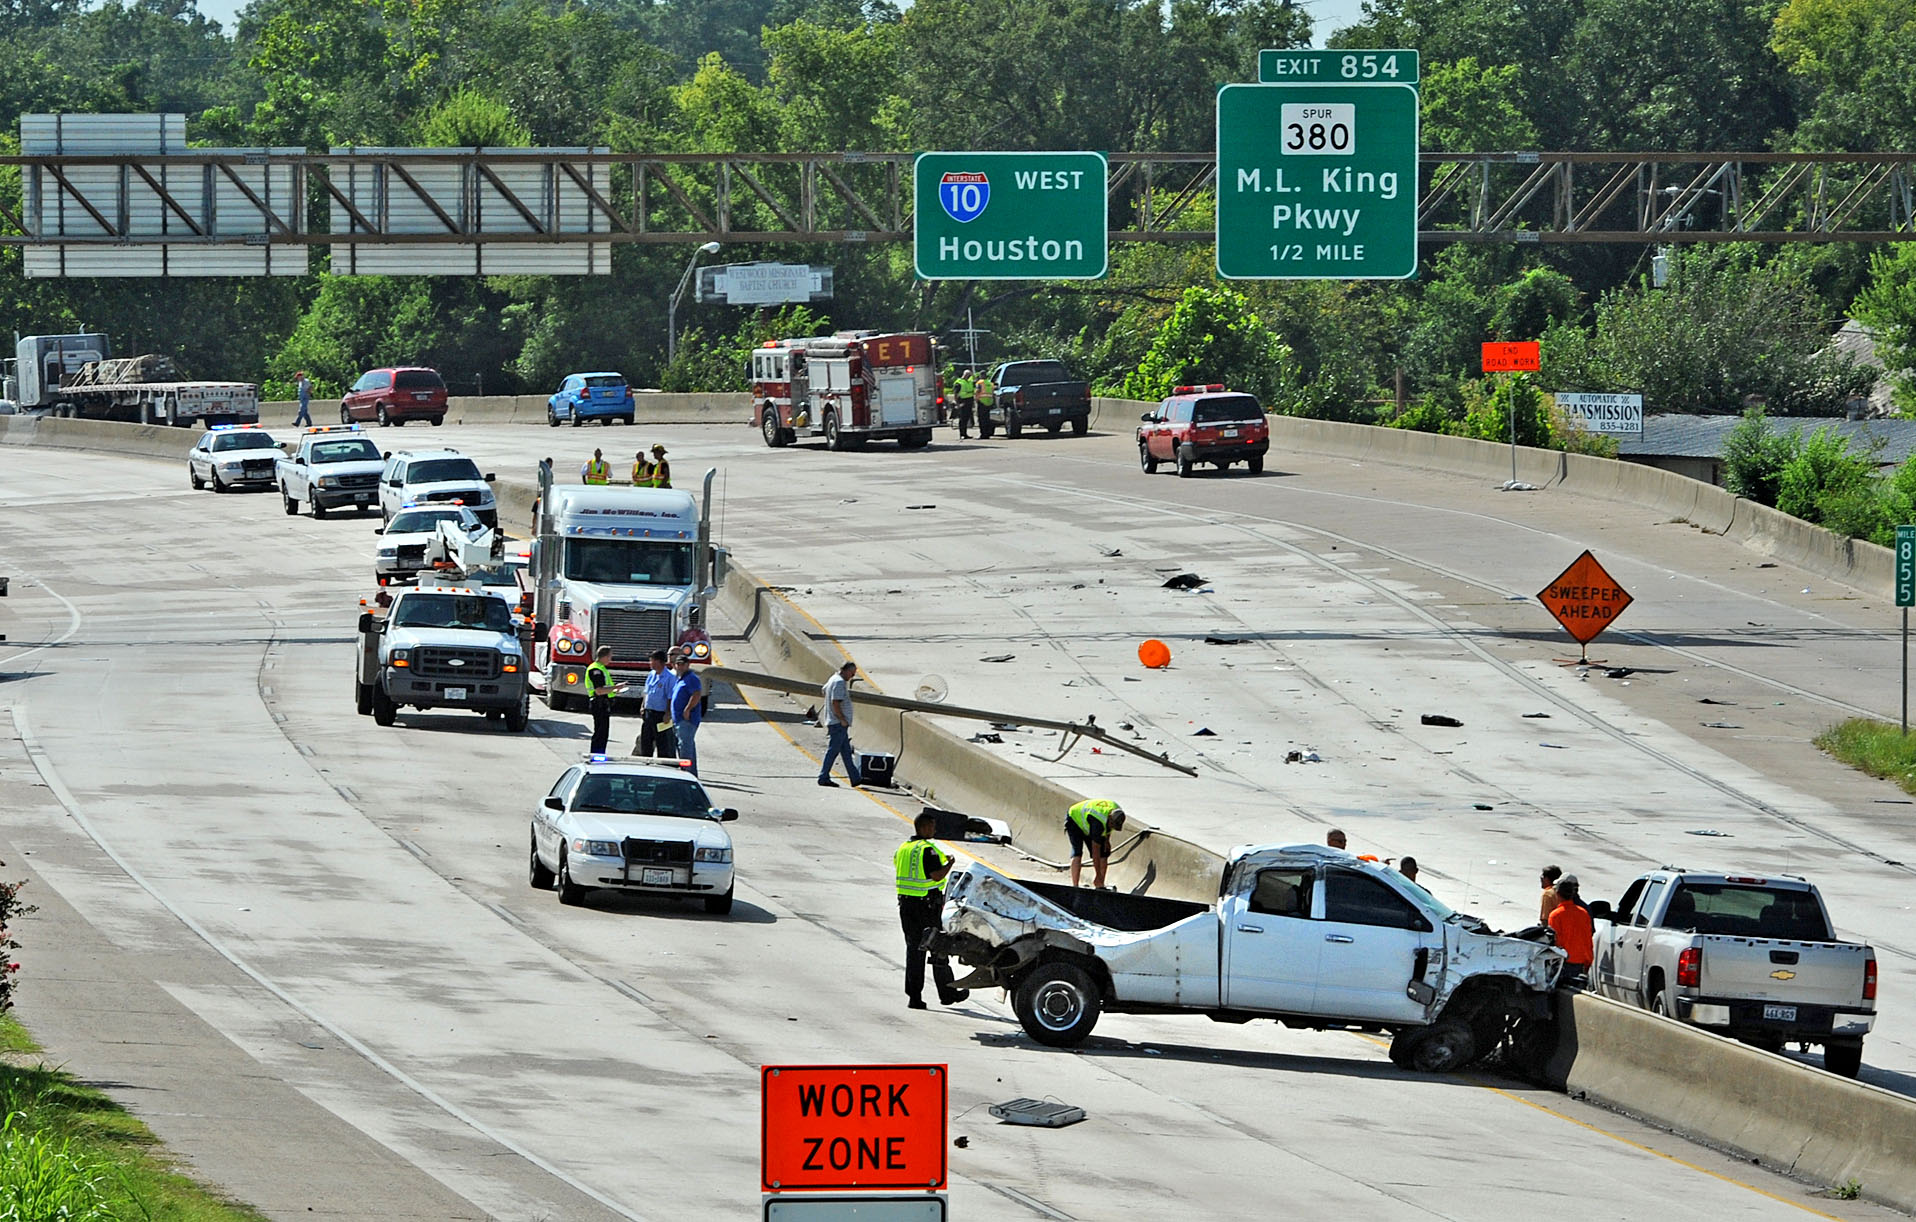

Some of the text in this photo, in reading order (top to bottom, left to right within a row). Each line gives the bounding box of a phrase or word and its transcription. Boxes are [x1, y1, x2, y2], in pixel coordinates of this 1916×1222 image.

[1276, 55, 1400, 78] EXIT 854
[1302, 109, 1333, 119] SPUR
[1286, 123, 1349, 150] 380
[946, 175, 983, 183] INTERSTATE
[1014, 171, 1084, 190] WEST
[1237, 166, 1398, 200] M.L. King
[950, 185, 981, 213] 10
[1272, 203, 1361, 236] Pkwy
[939, 236, 1084, 261] Houston
[1270, 244, 1365, 261] 1/2 MILE
[1503, 346, 1519, 356] END
[1486, 357, 1536, 367] ROAD WORK
[1579, 394, 1618, 404] AUTOMATIC
[1600, 421, 1640, 431] 835-4281
[1897, 530, 1915, 539] MILE
[1549, 586, 1621, 601] SWEEPER
[1559, 605, 1613, 619] AHEAD
[798, 1083, 911, 1118] WORK
[801, 1136, 907, 1171] ZONE
